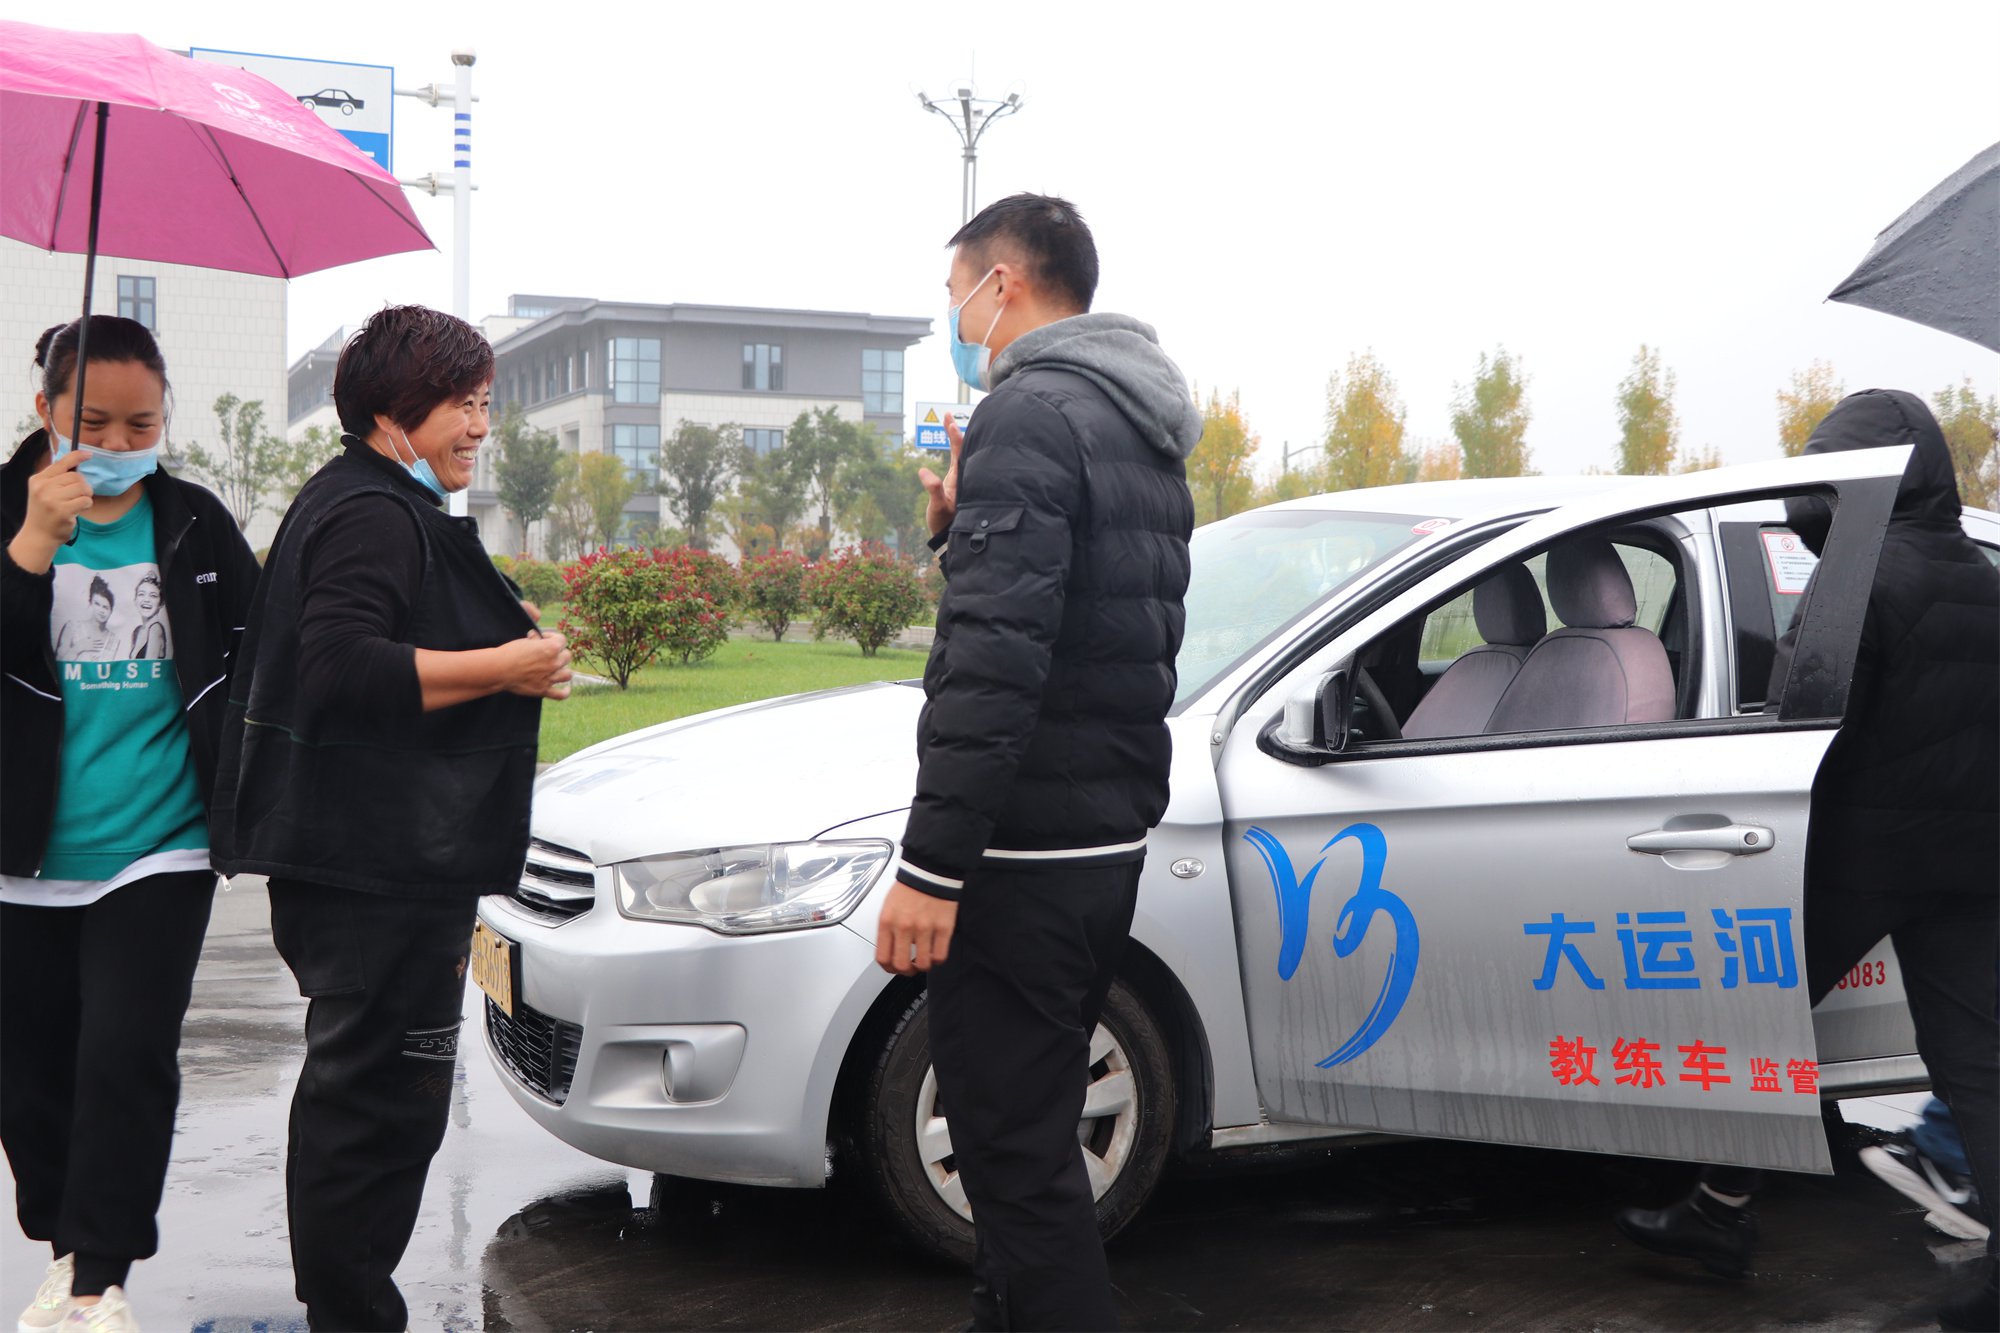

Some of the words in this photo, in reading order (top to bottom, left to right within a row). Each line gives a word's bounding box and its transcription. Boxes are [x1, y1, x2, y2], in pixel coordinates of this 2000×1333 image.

[64, 662, 162, 680] MUSE
[80, 682, 121, 691] Something
[1523, 907, 1799, 990] 大运河
[1549, 1035, 1731, 1091] 教练车
[1749, 1057, 1819, 1095] 监管
